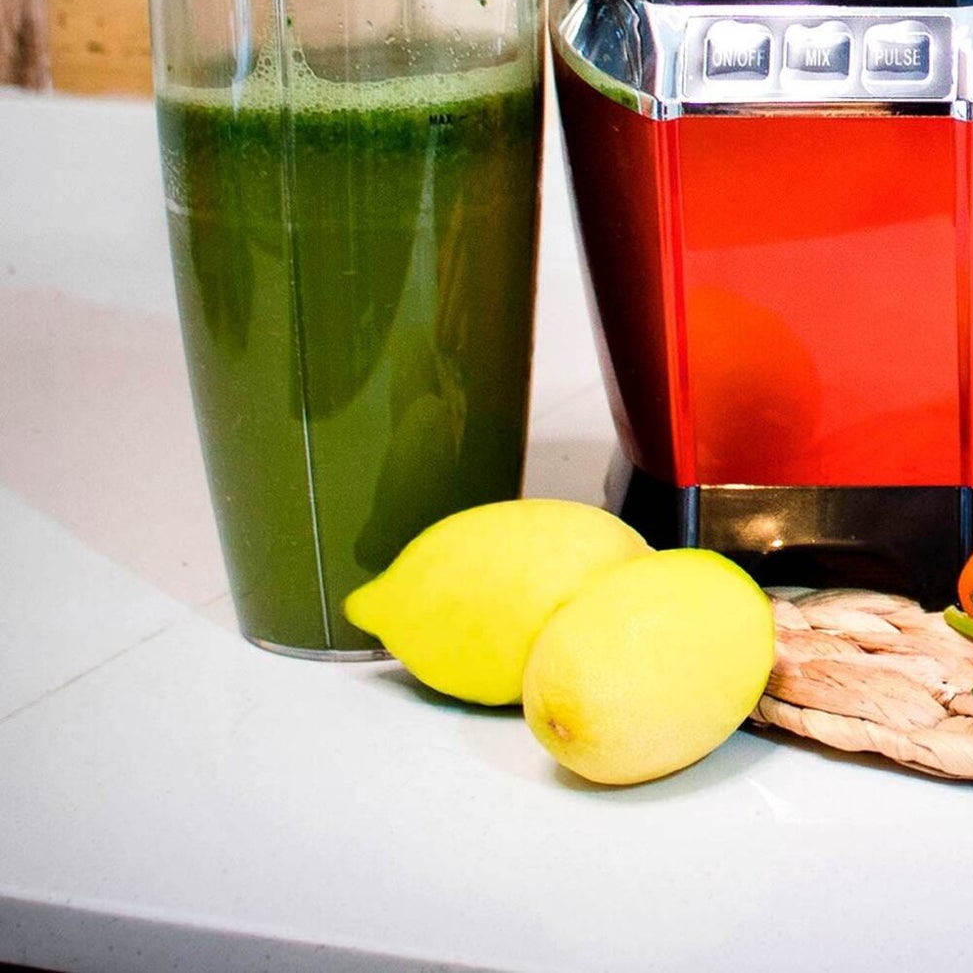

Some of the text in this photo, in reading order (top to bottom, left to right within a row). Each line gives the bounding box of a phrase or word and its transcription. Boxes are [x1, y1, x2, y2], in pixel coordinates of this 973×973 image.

[713, 49, 765, 67] ON/OFF
[805, 49, 832, 67] MIX
[874, 49, 921, 66] PULSE
